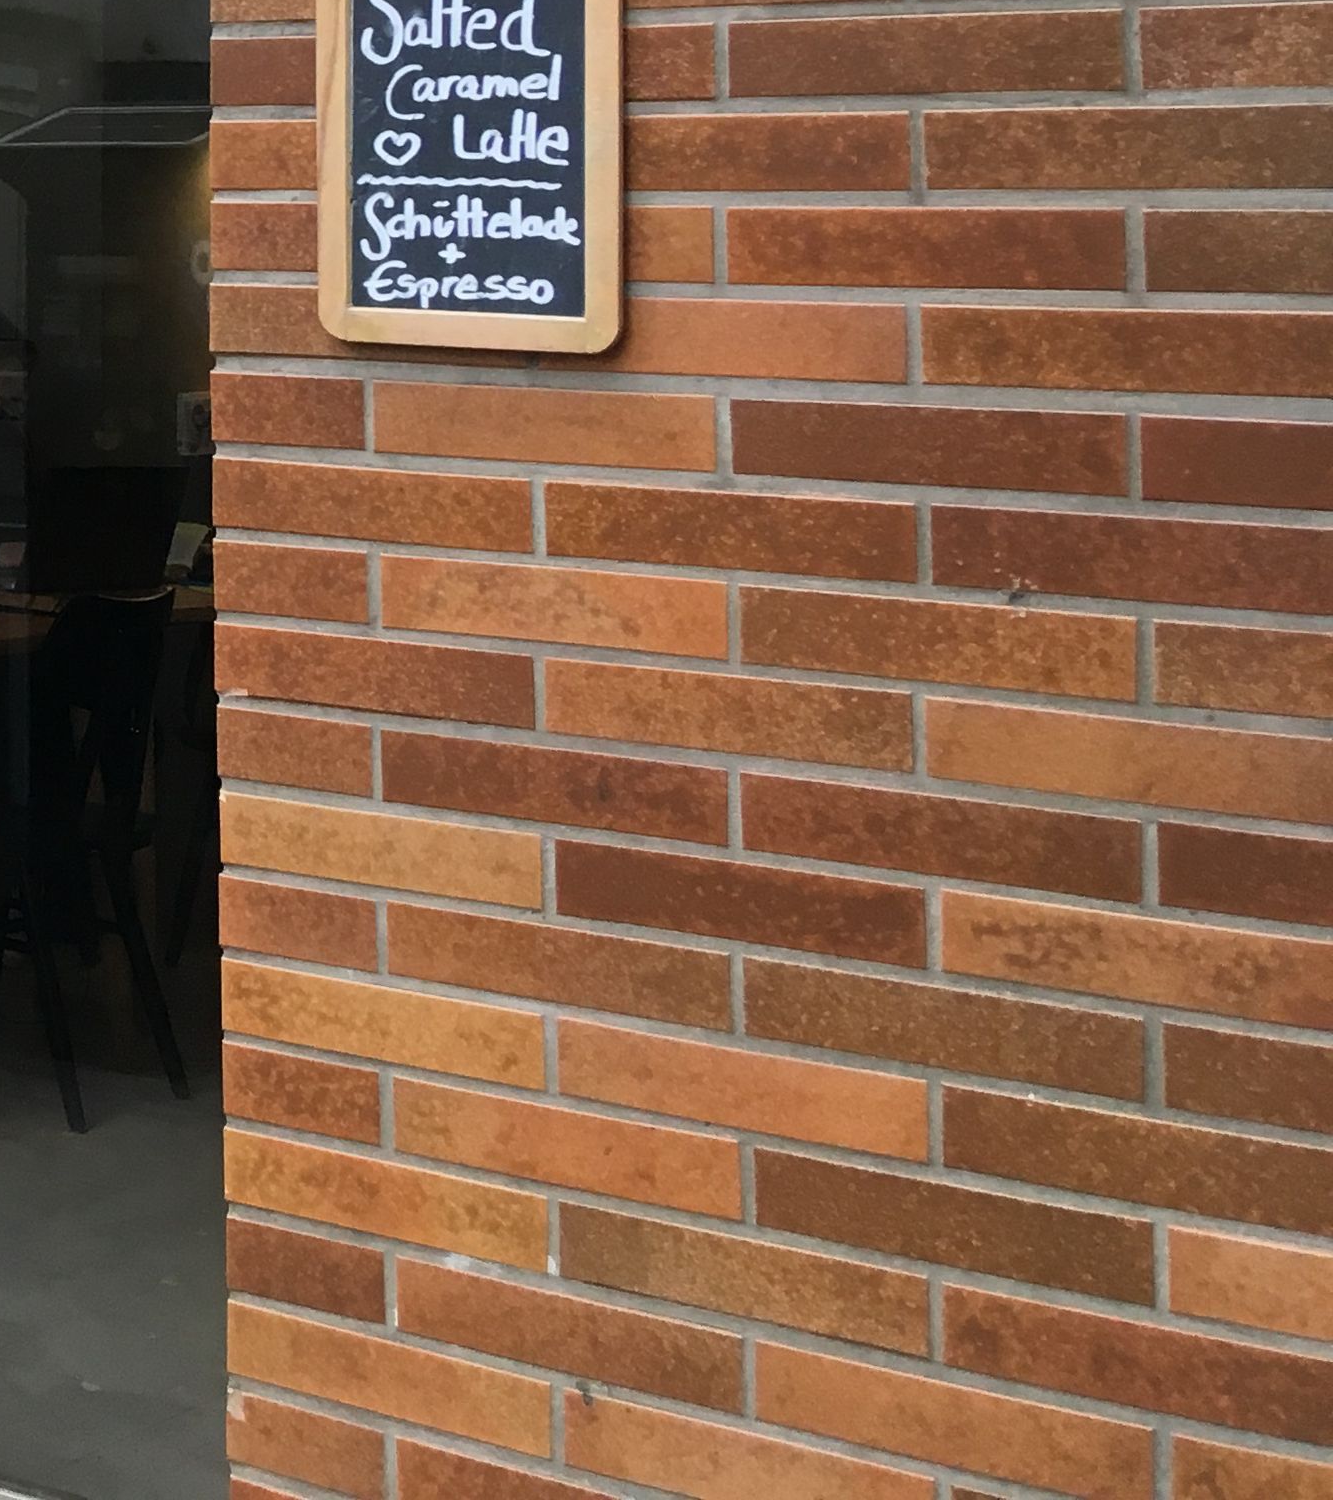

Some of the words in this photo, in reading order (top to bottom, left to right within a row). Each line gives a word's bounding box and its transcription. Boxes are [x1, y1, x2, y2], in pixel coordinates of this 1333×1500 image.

[385, 54, 562, 120] Caramel
[453, 108, 570, 166] Latte
[438, 242, 466, 264] +
[363, 259, 554, 309] Espresso
